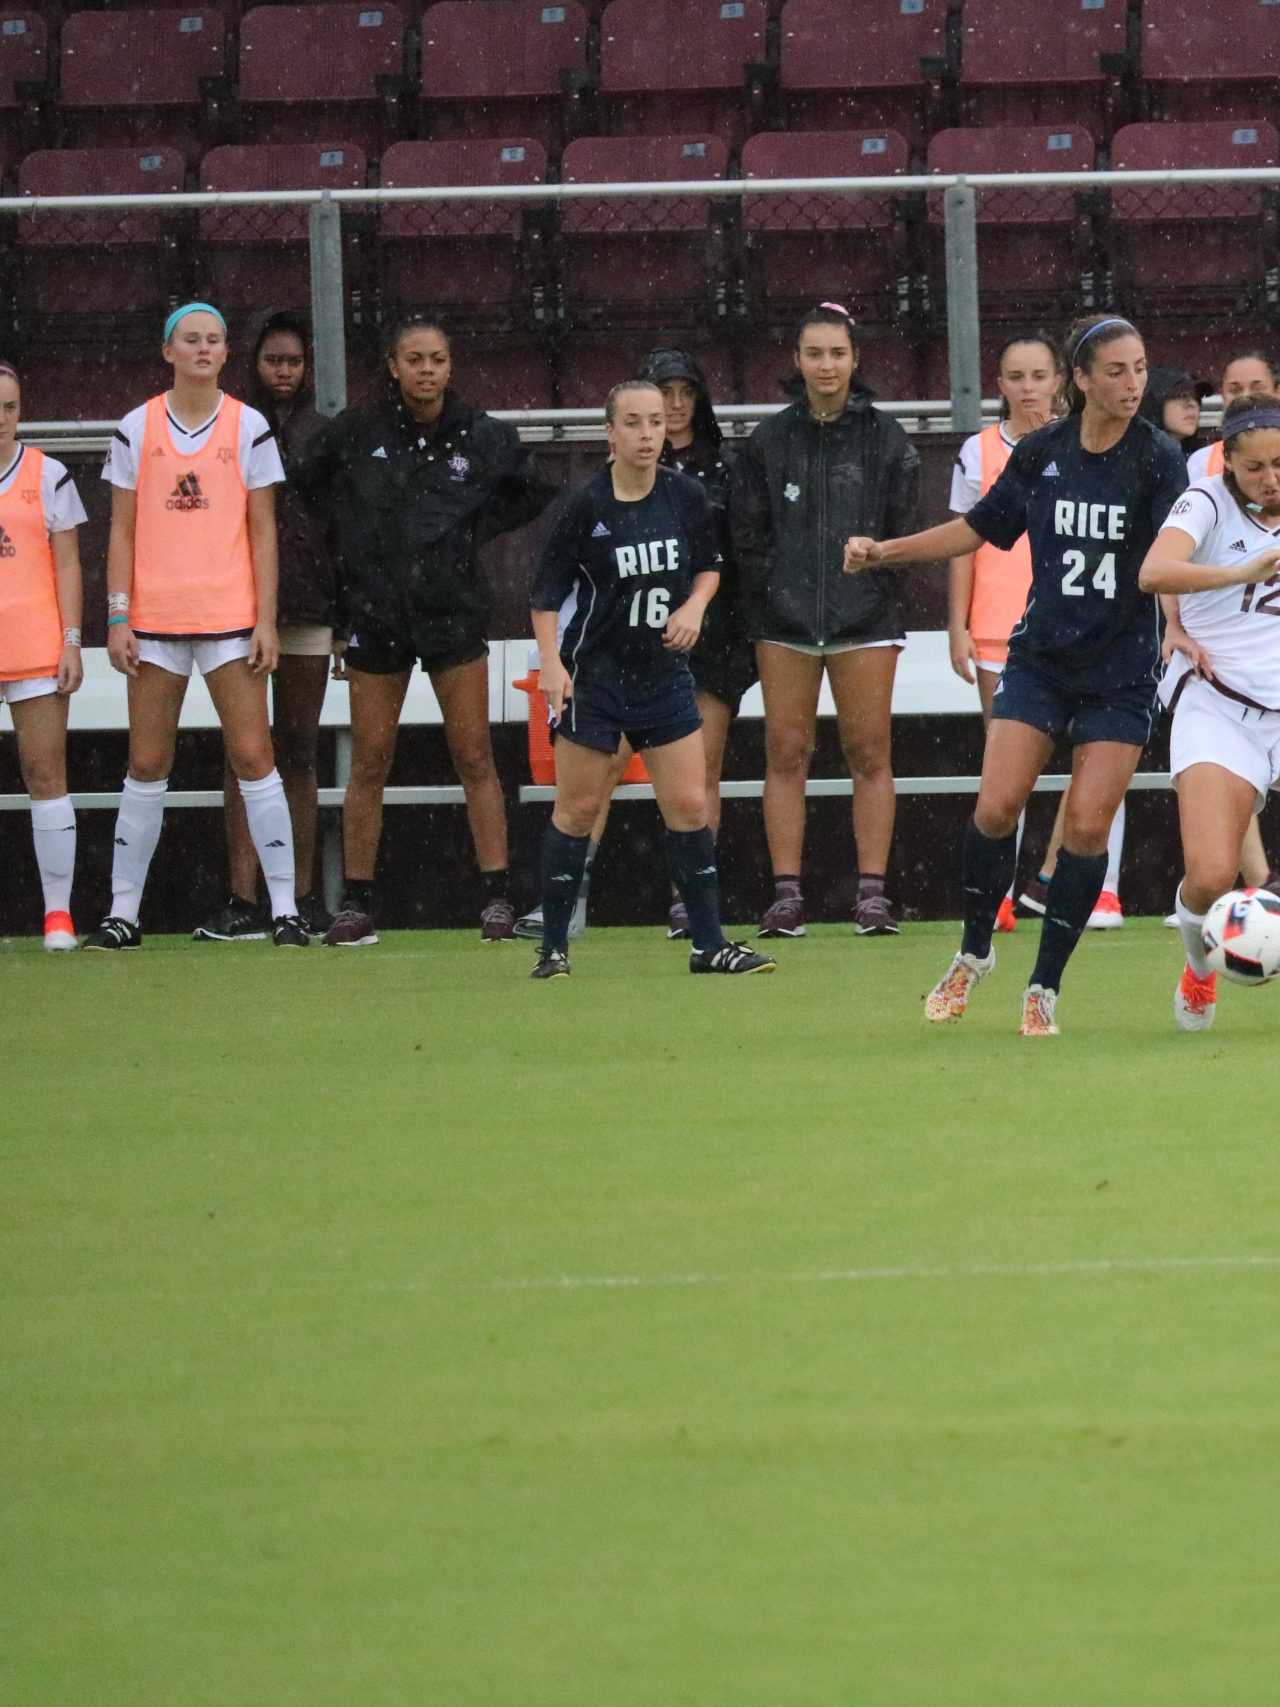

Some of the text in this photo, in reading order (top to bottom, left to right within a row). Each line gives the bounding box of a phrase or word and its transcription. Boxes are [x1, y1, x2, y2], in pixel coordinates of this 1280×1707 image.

[165, 496, 210, 511] adidas
[1054, 499, 1127, 540] RICE
[1171, 500, 1190, 515] SEC
[615, 538, 679, 578] RICE
[1061, 549, 1117, 599] 24
[629, 587, 671, 629] 16
